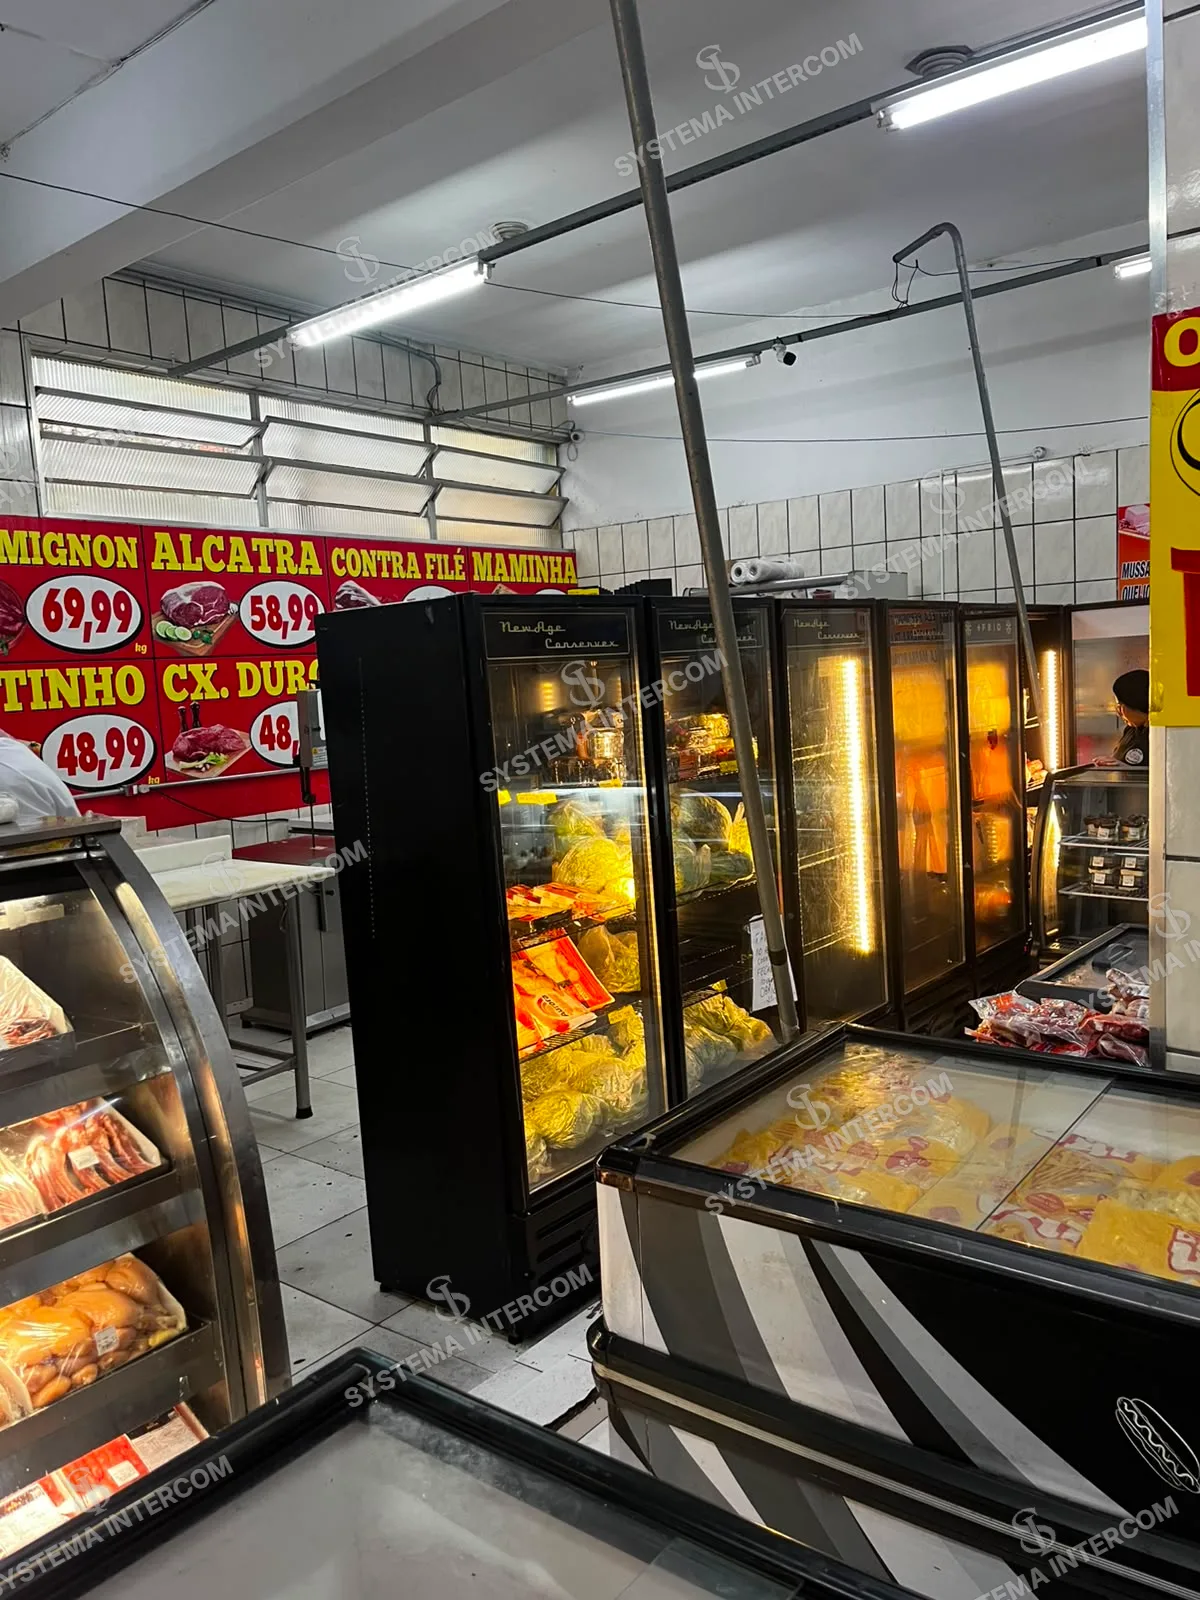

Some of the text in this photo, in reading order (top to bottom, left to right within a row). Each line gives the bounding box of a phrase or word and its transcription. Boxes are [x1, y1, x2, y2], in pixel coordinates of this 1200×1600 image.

[0, 529, 138, 568] MIGNON
[151, 532, 323, 576] ALCATRA
[331, 547, 466, 581] CONTRA FILÉ
[472, 551, 577, 584] MAMINHA
[42, 587, 132, 643] 69,99
[250, 593, 318, 640] 58,99
[135, 642, 147, 654] kg
[0, 665, 145, 712] TINHO
[163, 663, 229, 702] CX.
[57, 725, 146, 781] 48,99
